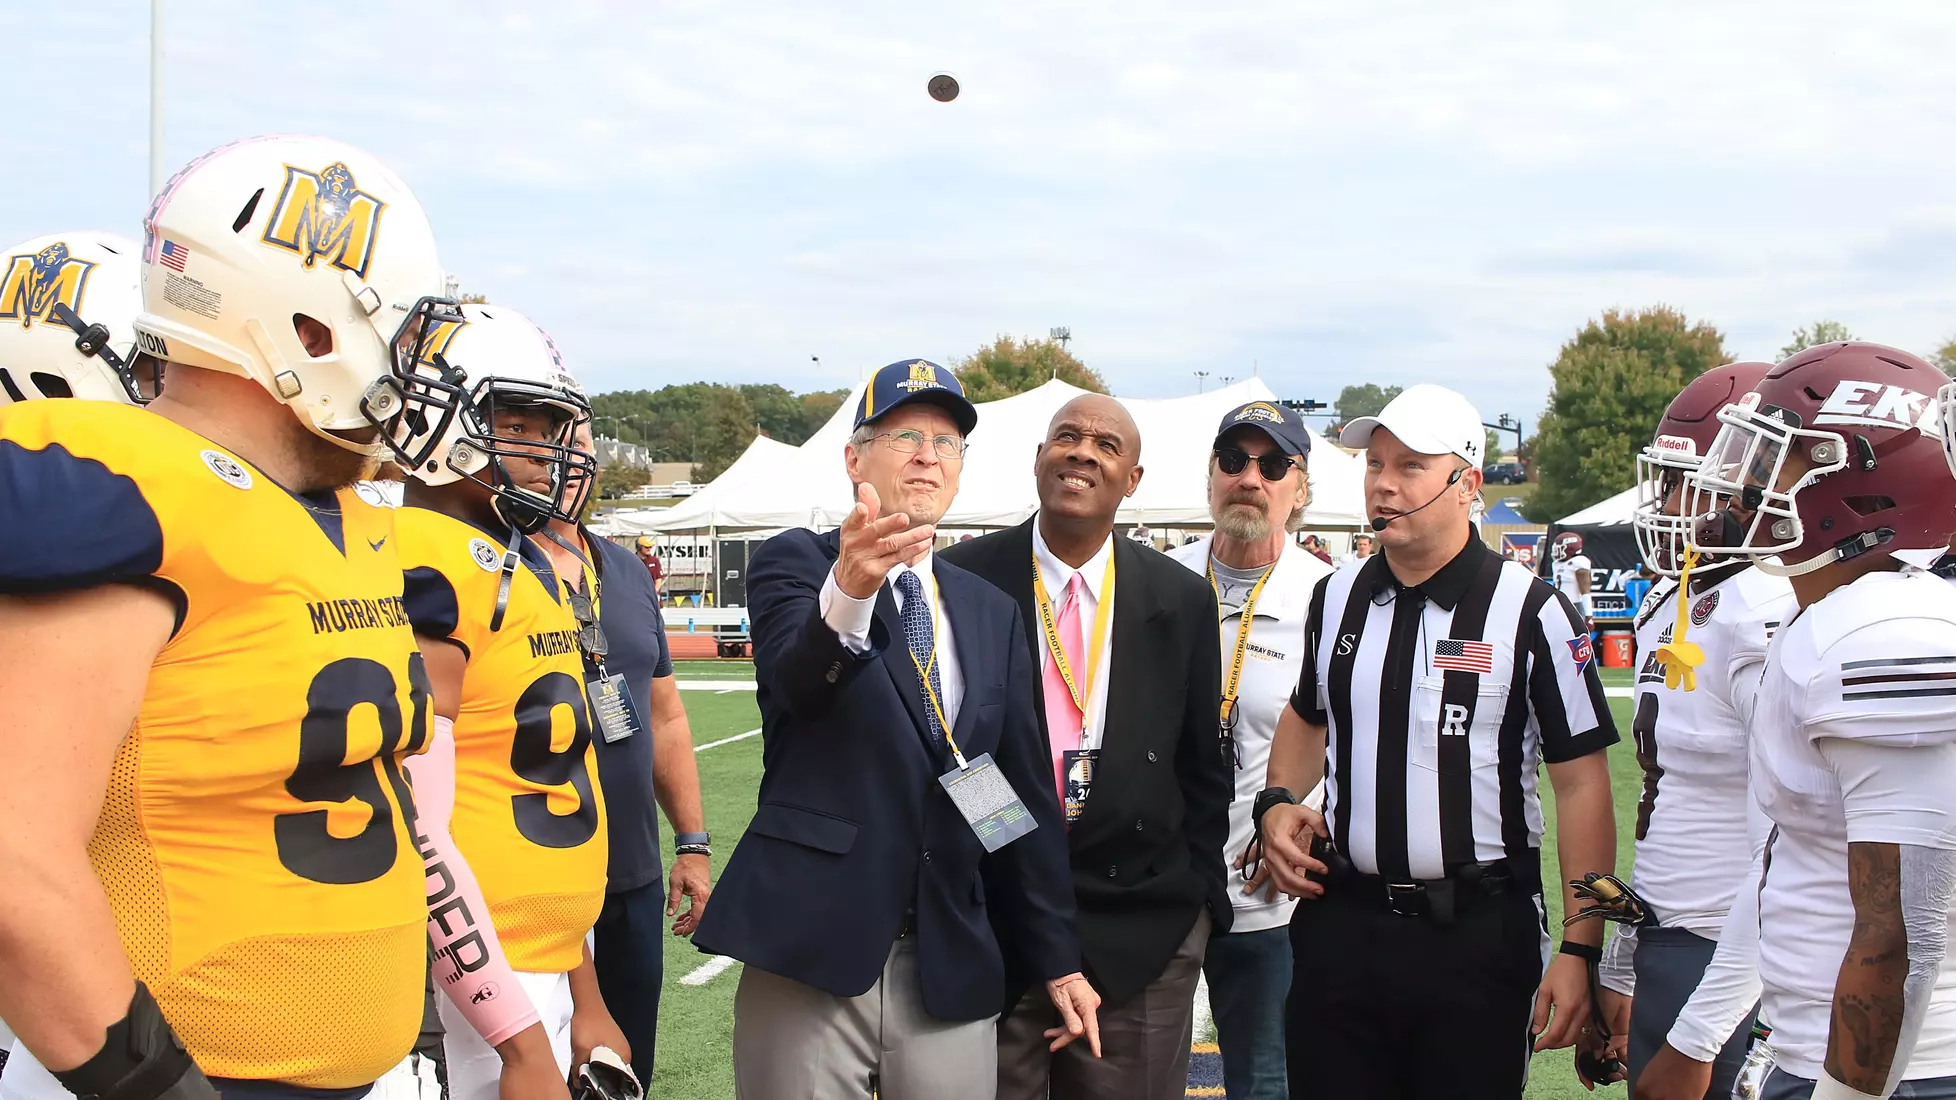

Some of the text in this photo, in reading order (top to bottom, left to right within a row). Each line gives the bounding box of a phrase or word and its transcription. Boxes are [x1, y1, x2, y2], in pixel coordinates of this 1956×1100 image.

[1657, 437, 1689, 451] Riddell
[306, 599, 384, 634] MURRAY
[527, 630, 575, 659] MURRAY
[1041, 602, 1053, 629] RACER
[1048, 629, 1067, 671] FOOTBALL
[1227, 599, 1254, 696] RACER FOOTBALL ALUMNI
[1336, 633, 1357, 656] S
[1266, 648, 1286, 660] STATE
[1441, 703, 1469, 736] R
[510, 671, 599, 849] 9
